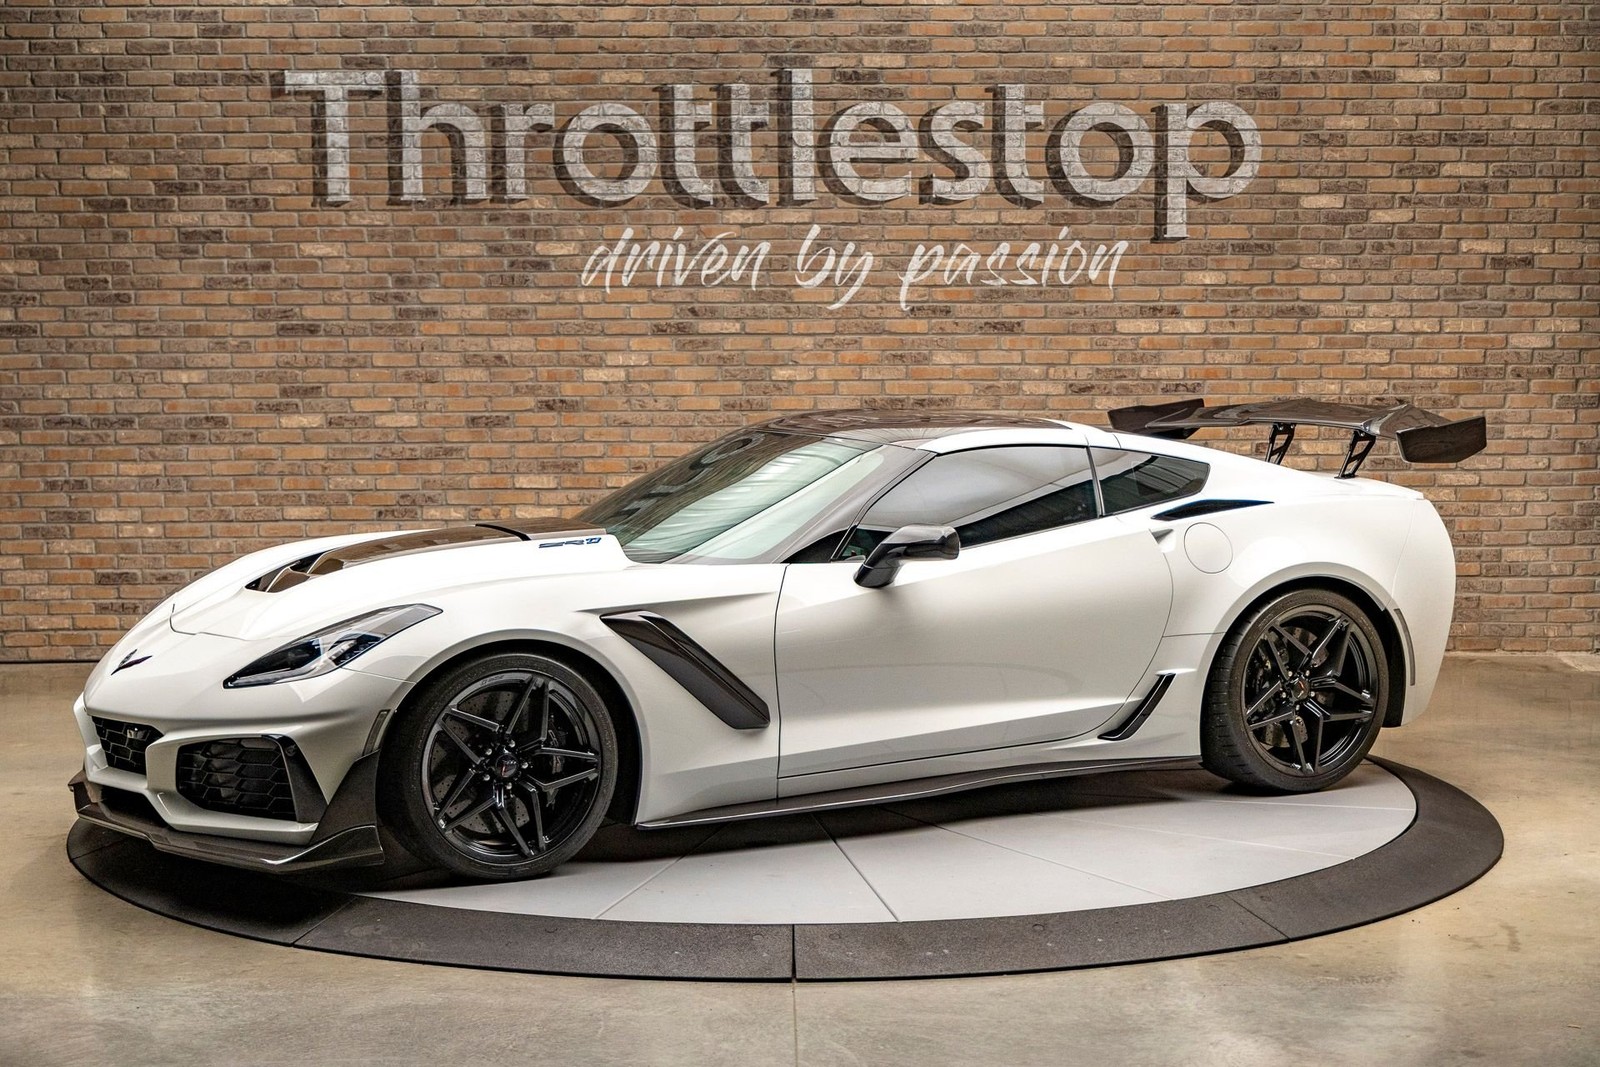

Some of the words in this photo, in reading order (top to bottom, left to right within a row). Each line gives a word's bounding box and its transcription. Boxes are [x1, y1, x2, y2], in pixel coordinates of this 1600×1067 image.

[276, 67, 1262, 241] Throttlestop
[580, 226, 772, 294] driven
[795, 224, 874, 310] by
[897, 226, 1129, 311] passion
